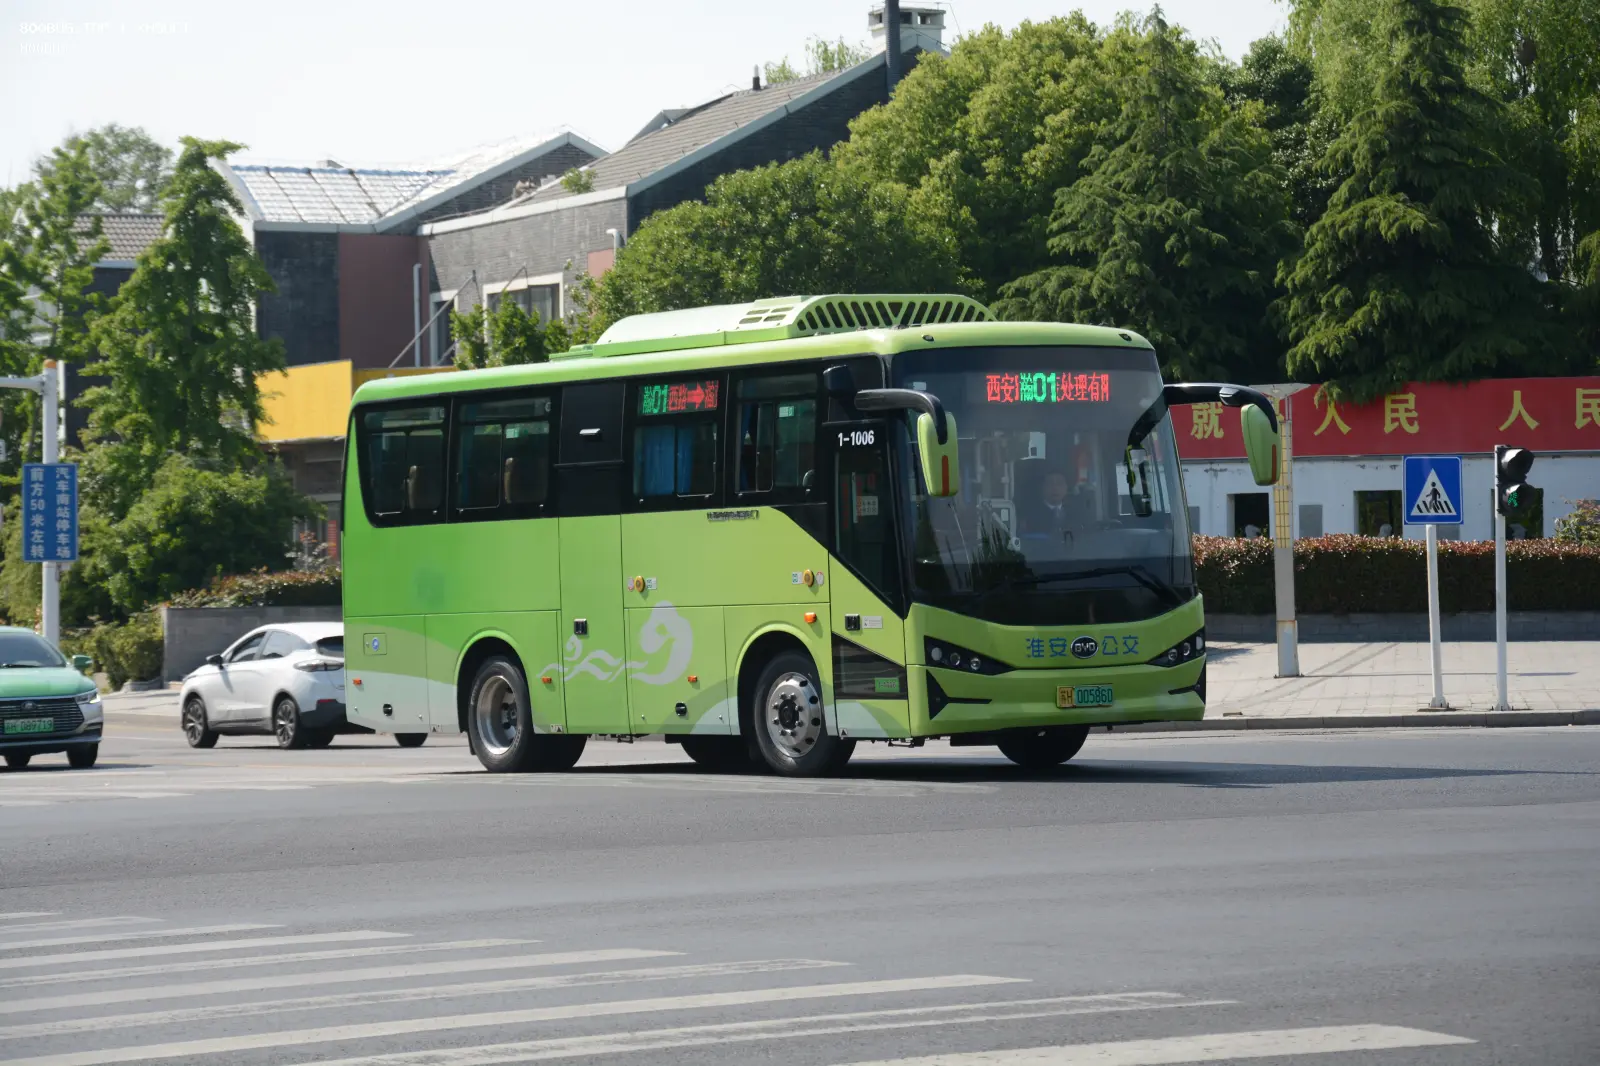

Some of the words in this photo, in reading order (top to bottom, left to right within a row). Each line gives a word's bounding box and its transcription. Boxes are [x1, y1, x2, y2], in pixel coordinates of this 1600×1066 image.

[837, 430, 875, 447] 1-1006
[30, 467, 45, 558] 前方50米左转
[1025, 637, 1067, 658] 淮安
[1074, 642, 1096, 652] BYD
[1102, 635, 1139, 655] 公交
